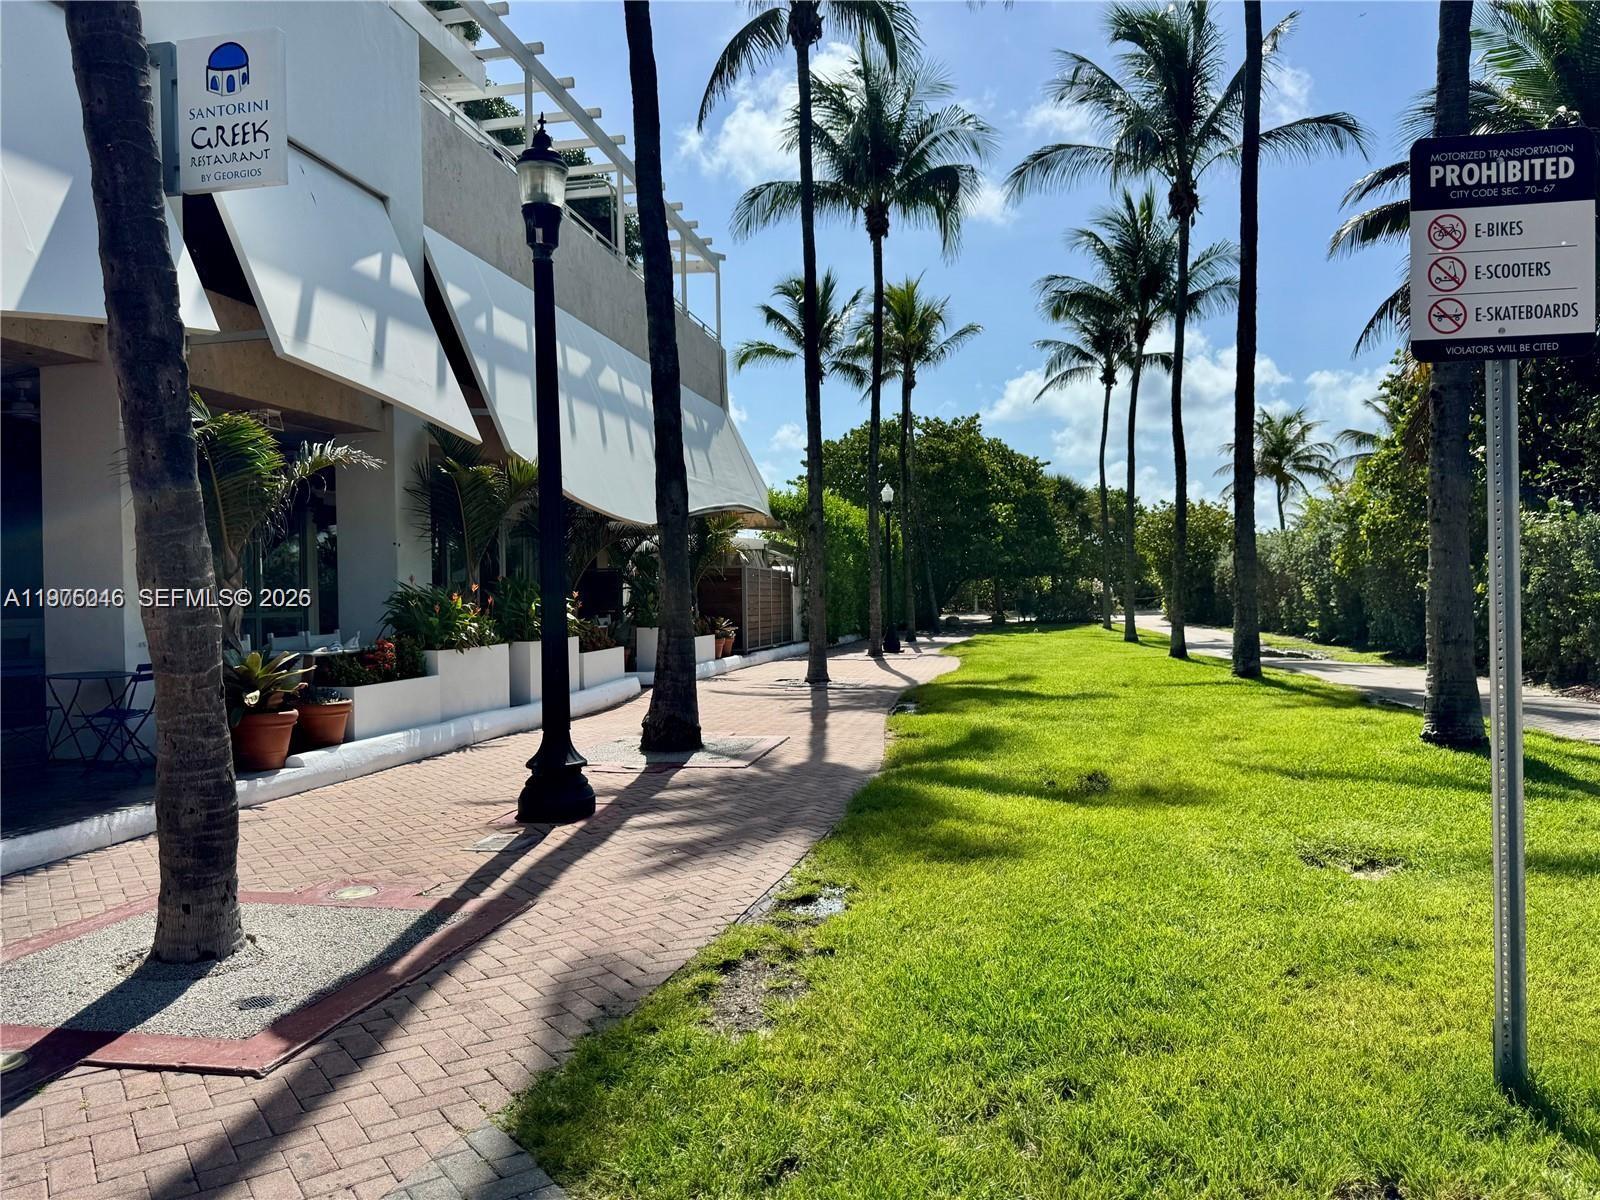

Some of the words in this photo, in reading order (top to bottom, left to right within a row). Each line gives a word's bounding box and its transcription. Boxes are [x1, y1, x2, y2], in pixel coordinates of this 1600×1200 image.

[189, 99, 269, 120] SANTORINI
[191, 119, 269, 149] GREEK
[190, 148, 270, 167] RESTAURANT
[1430, 150, 1486, 162] MOTORIZED
[1489, 144, 1574, 158] TRANSPORTATION
[201, 174, 211, 182] BY
[1430, 156, 1575, 187] PROHIBITED
[1450, 190, 1470, 199] CITY
[1471, 188, 1499, 197] CODE
[1501, 186, 1522, 196] SEC.
[1475, 221, 1523, 238] E-BIKES
[1475, 261, 1551, 280] E-SCOOTERS
[1475, 302, 1579, 322] E-SKATEBOARDS
[1445, 345, 1494, 355] VIOLATORS
[1497, 344, 1517, 353] WILL
[1519, 343, 1530, 352] BE
[1533, 342, 1559, 351] CITED
